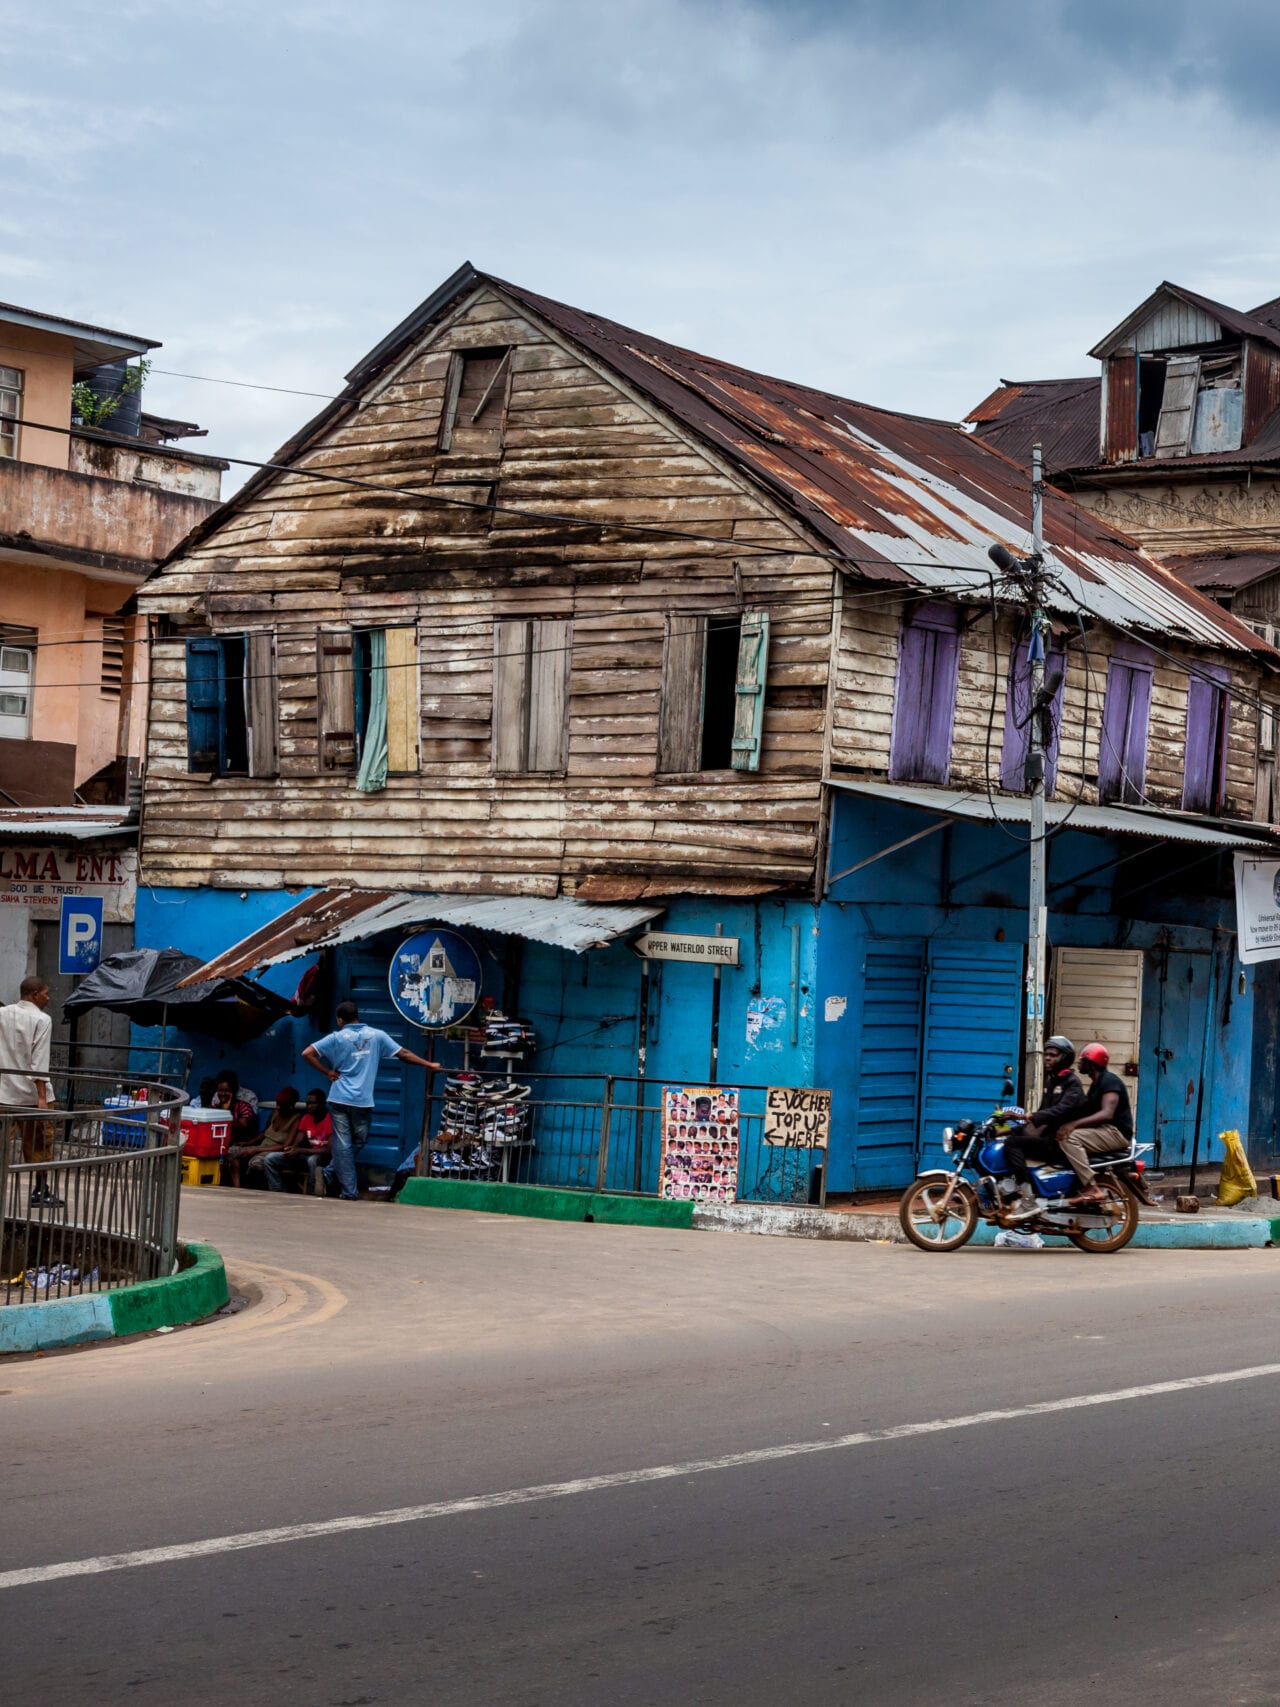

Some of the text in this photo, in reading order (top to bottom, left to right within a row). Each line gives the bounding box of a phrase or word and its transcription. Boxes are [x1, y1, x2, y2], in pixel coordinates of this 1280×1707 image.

[75, 855, 123, 881] ENT.
[10, 884, 28, 893] GOD
[23, 895, 59, 905] STEVENS
[1258, 914, 1275, 922] Universal
[67, 913, 96, 957] P
[647, 941, 733, 956] UPPER WATERLOO STREET
[772, 1112, 826, 1133] TOP UP
[785, 1130, 825, 1149] HERE
